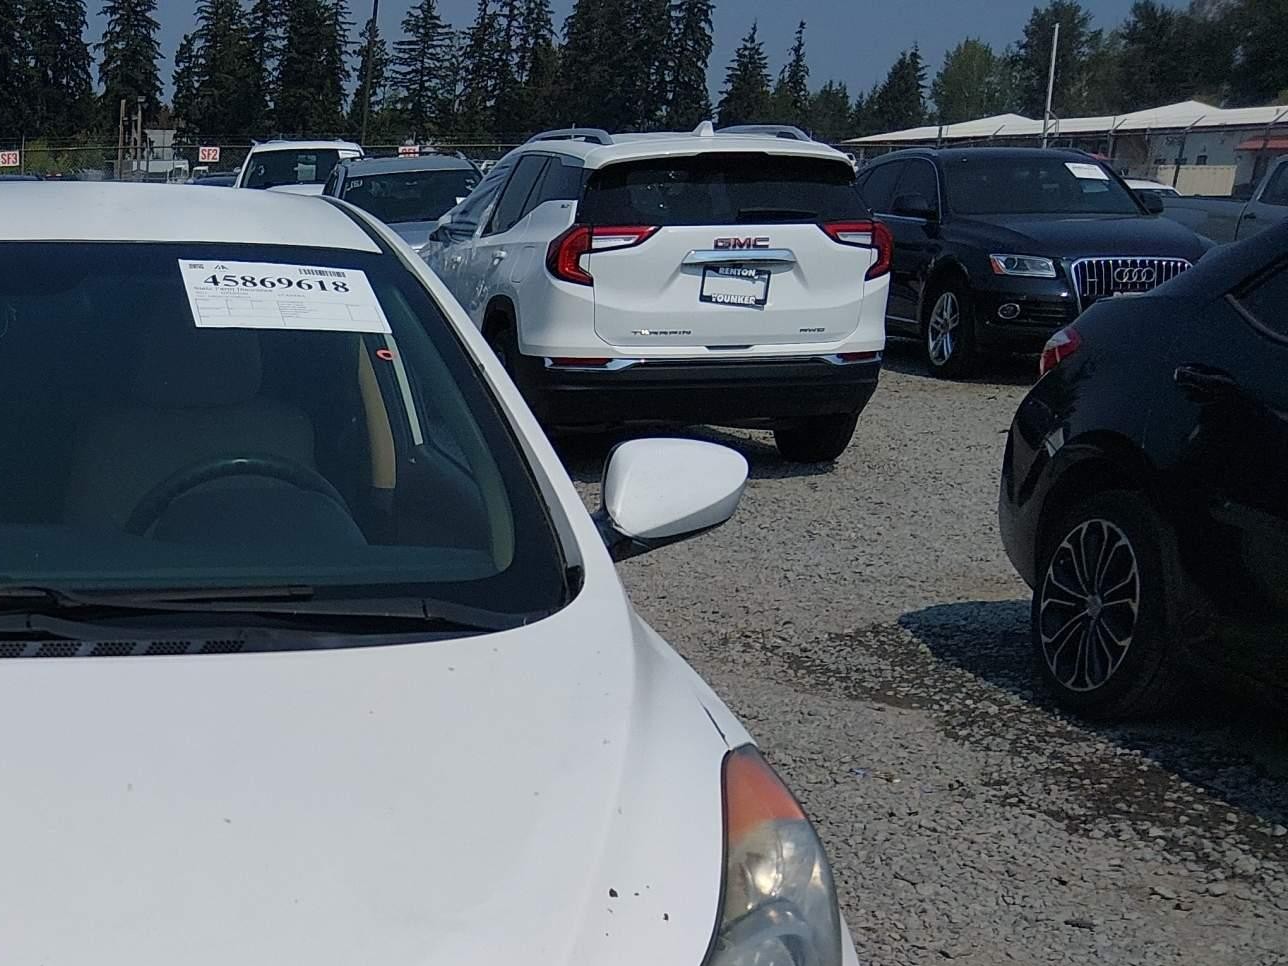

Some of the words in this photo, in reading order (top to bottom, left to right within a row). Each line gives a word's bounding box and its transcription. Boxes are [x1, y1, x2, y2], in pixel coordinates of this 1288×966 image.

[1, 153, 17, 165] SF3
[200, 148, 217, 160] SF2
[713, 237, 770, 249] GMC
[204, 274, 350, 293] 45869618
